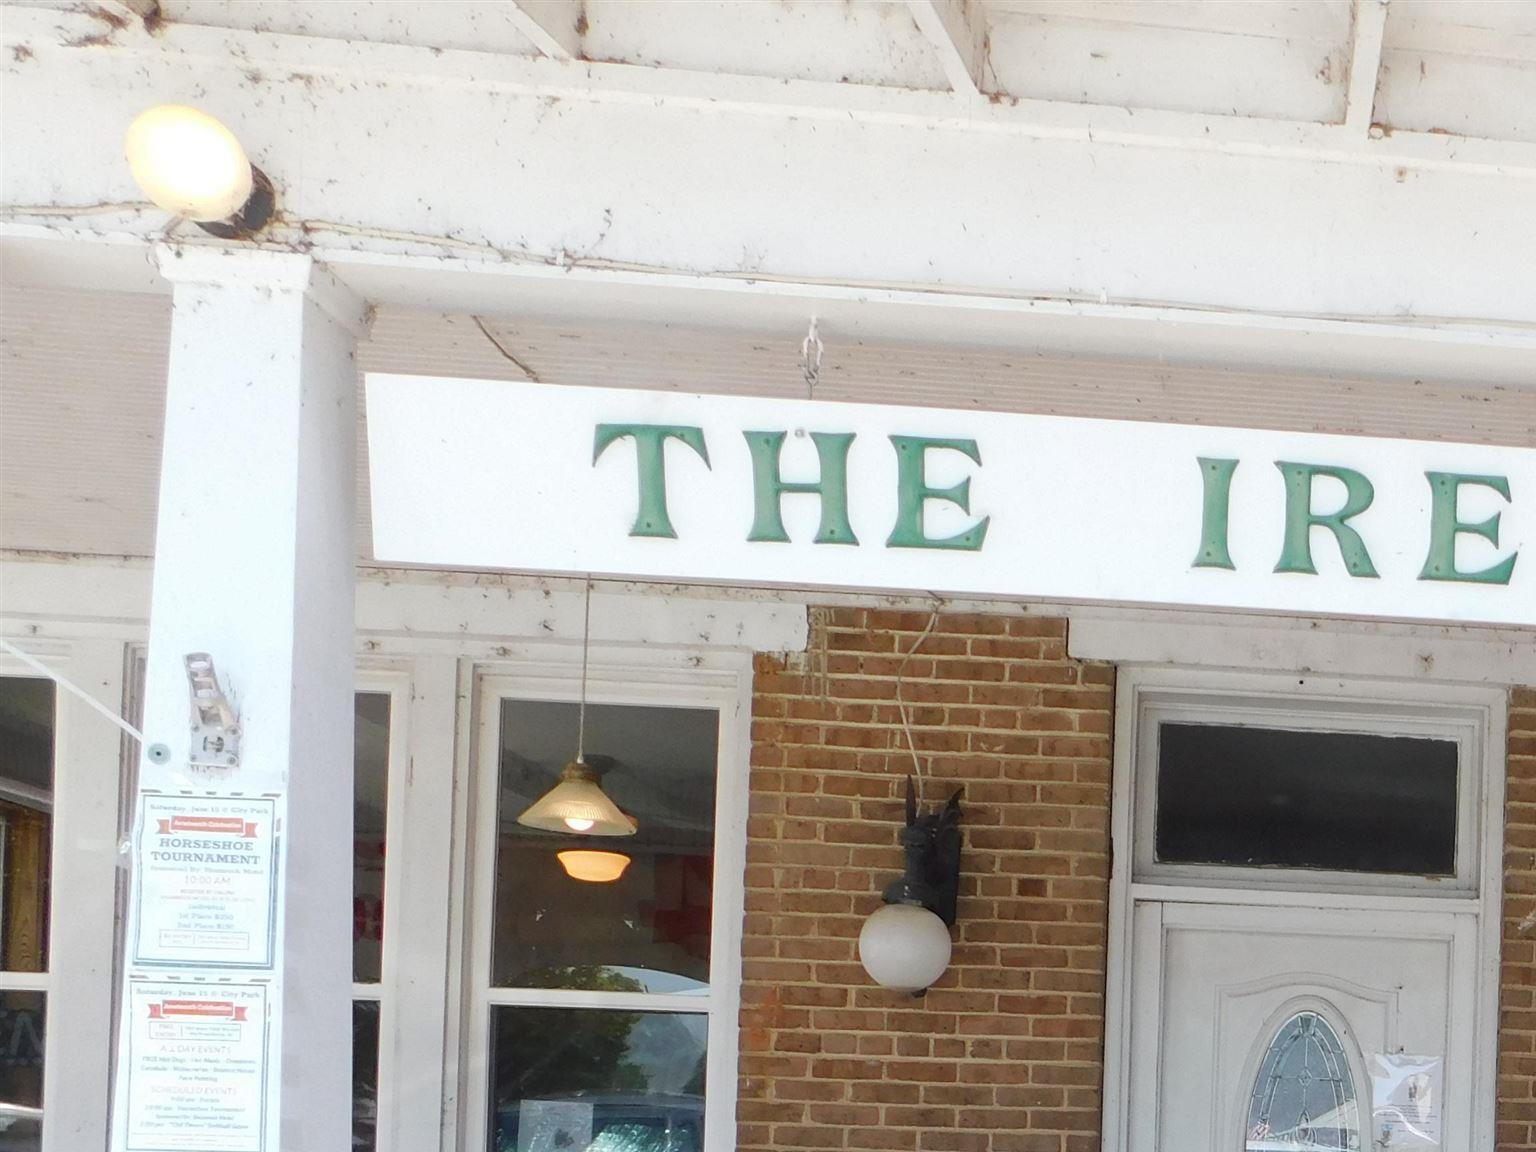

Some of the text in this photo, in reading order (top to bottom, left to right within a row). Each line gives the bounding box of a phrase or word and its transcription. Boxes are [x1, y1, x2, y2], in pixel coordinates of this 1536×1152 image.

[592, 422, 991, 552] THE
[230, 806, 248, 814] City
[158, 837, 255, 852] HORSESHOE
[150, 850, 261, 865] TOURNAMENT
[213, 877, 231, 885] AM
[220, 990, 239, 999] City
[177, 1045, 196, 1053] DAY
[197, 1045, 232, 1055] EVENTS
[204, 1086, 238, 1096] EVENTS
